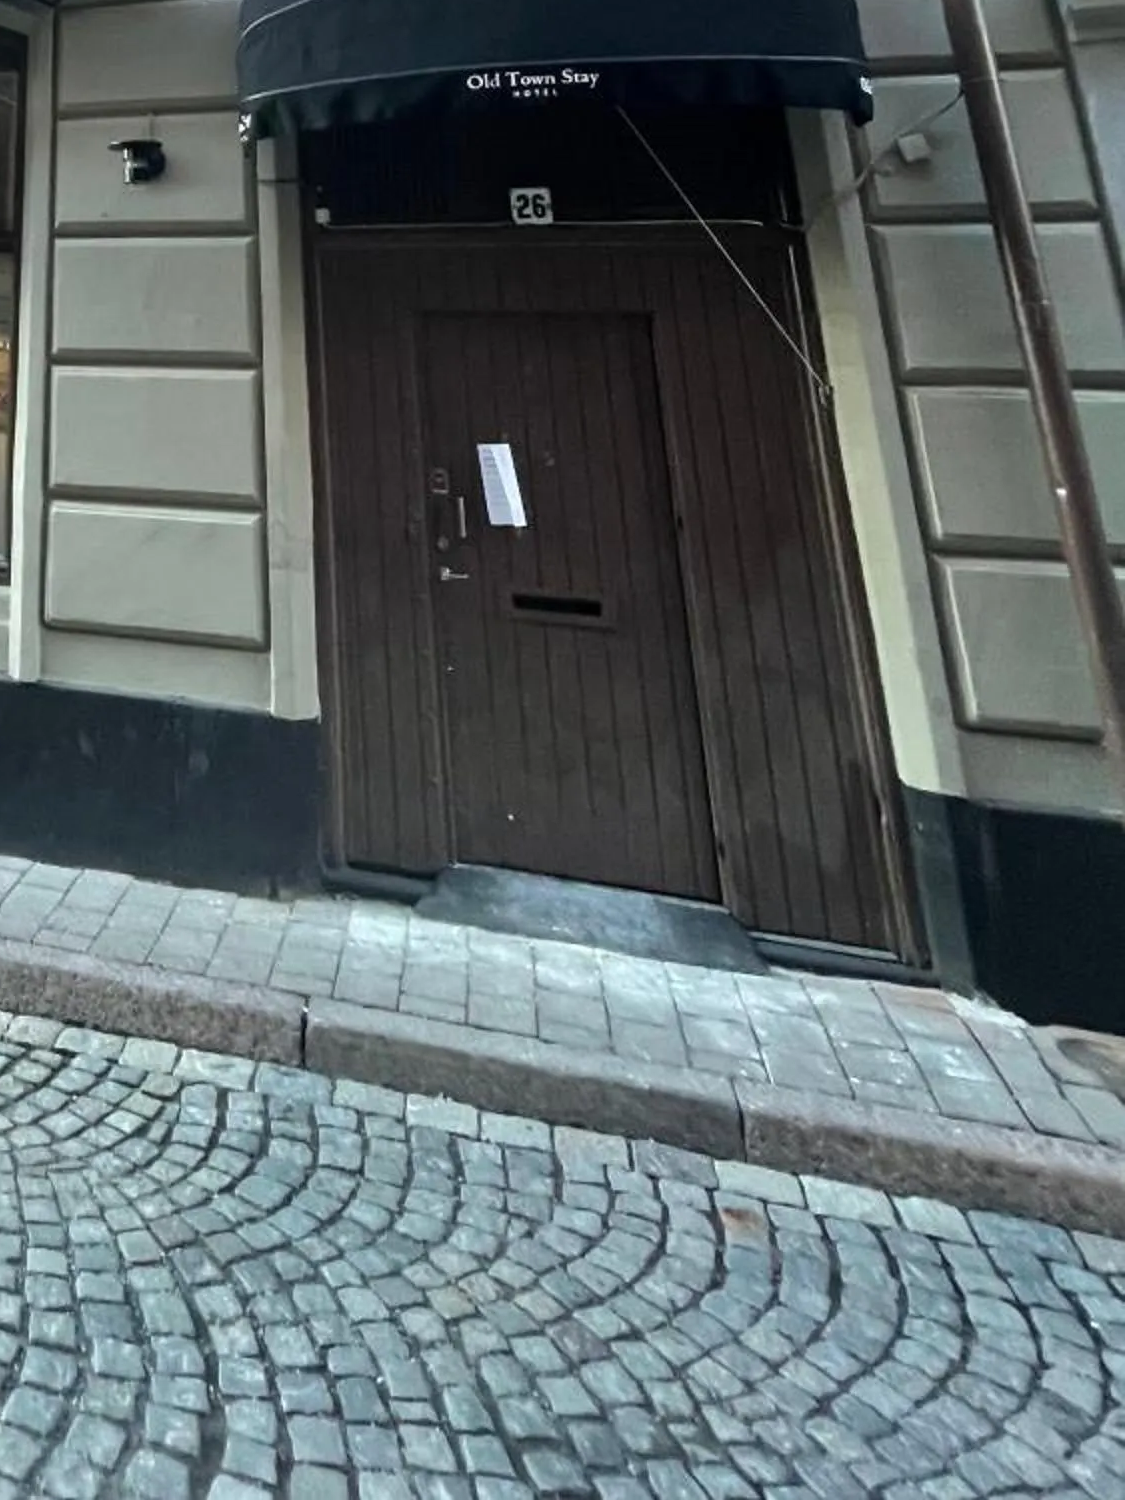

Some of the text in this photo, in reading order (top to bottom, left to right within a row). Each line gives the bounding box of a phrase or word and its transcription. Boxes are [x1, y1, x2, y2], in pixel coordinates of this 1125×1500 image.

[466, 68, 600, 89] Old Town Stay
[516, 194, 546, 219] 26
